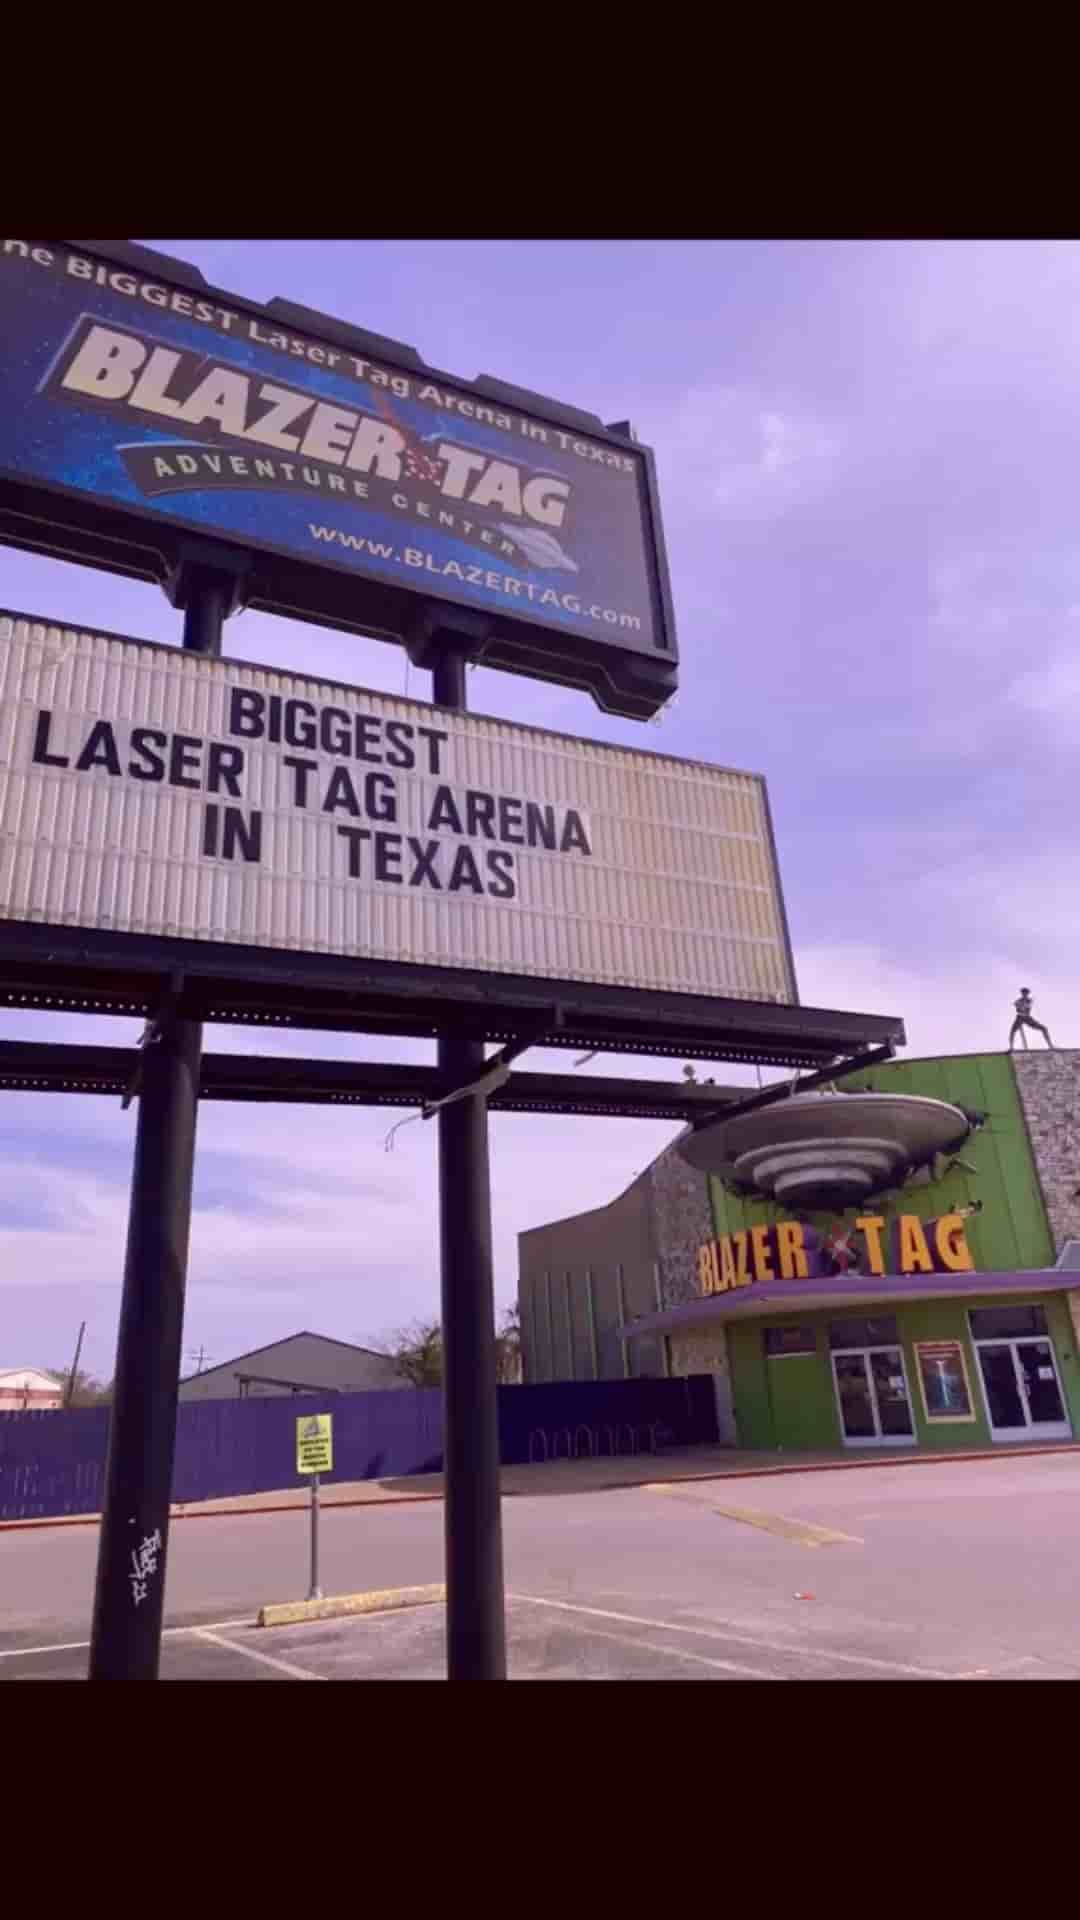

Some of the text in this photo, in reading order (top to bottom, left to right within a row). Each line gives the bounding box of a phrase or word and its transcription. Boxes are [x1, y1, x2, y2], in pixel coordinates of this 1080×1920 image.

[66, 254, 238, 331] BIGGEST
[248, 318, 342, 368] Laser
[350, 356, 412, 399] Tag
[416, 383, 513, 428] Arena
[519, 416, 549, 440] in
[556, 433, 637, 474] Texas
[61, 323, 571, 528] BLAZER TAG
[152, 454, 518, 556] ADVENTURE CENTER
[308, 523, 642, 632] www.BLAZERTAG.com
[32, 710, 592, 856] LASER TAG ARENA
[230, 686, 448, 776] BIGGEST
[202, 803, 517, 899] IN TEXAS
[699, 1215, 974, 1296] BLAZER TAG
